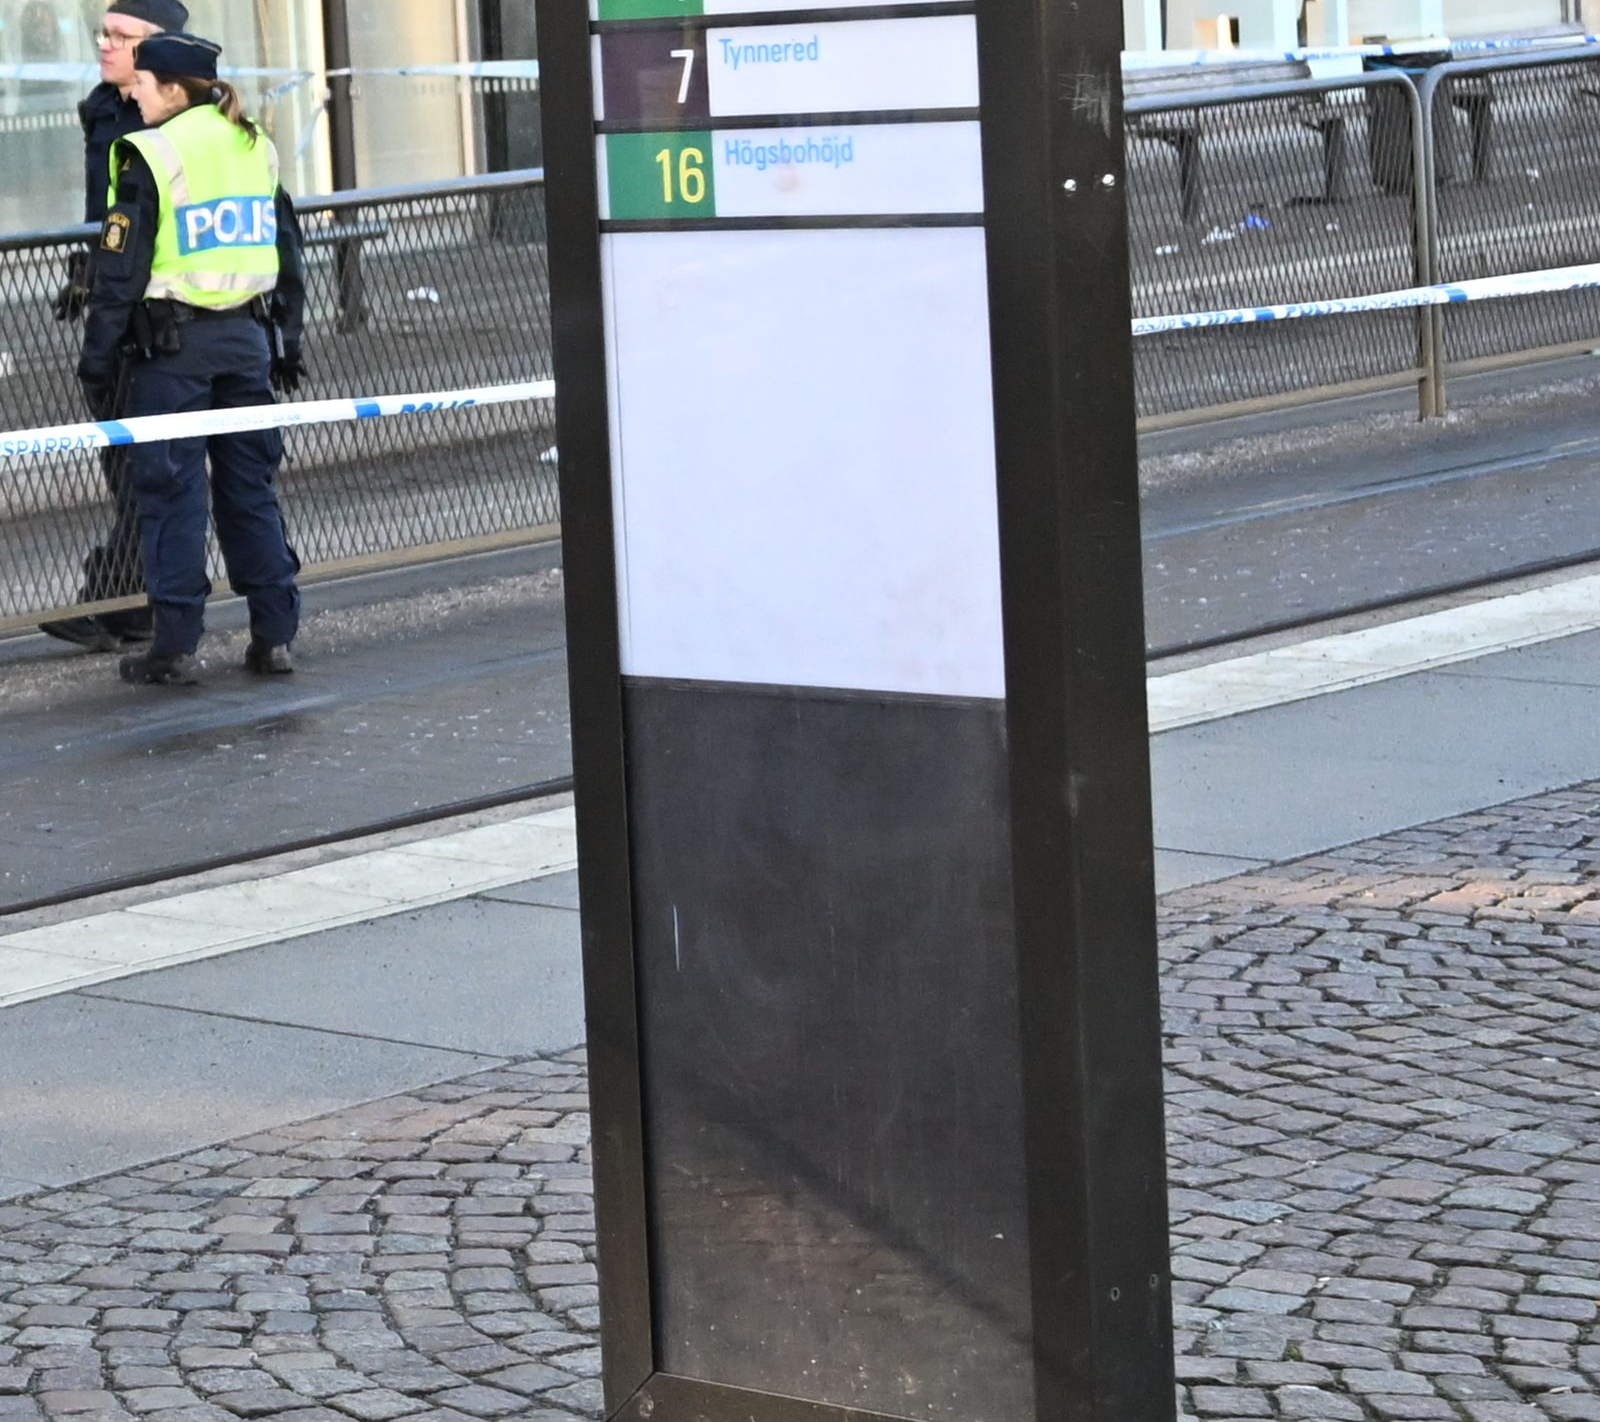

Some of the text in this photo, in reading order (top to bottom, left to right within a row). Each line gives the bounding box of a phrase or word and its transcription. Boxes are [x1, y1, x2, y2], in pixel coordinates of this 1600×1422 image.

[670, 49, 694, 104] 7
[719, 36, 819, 70] Tynnered
[655, 147, 706, 203] 16
[725, 136, 853, 171] Högsbohöjd
[186, 200, 275, 249] POLIS
